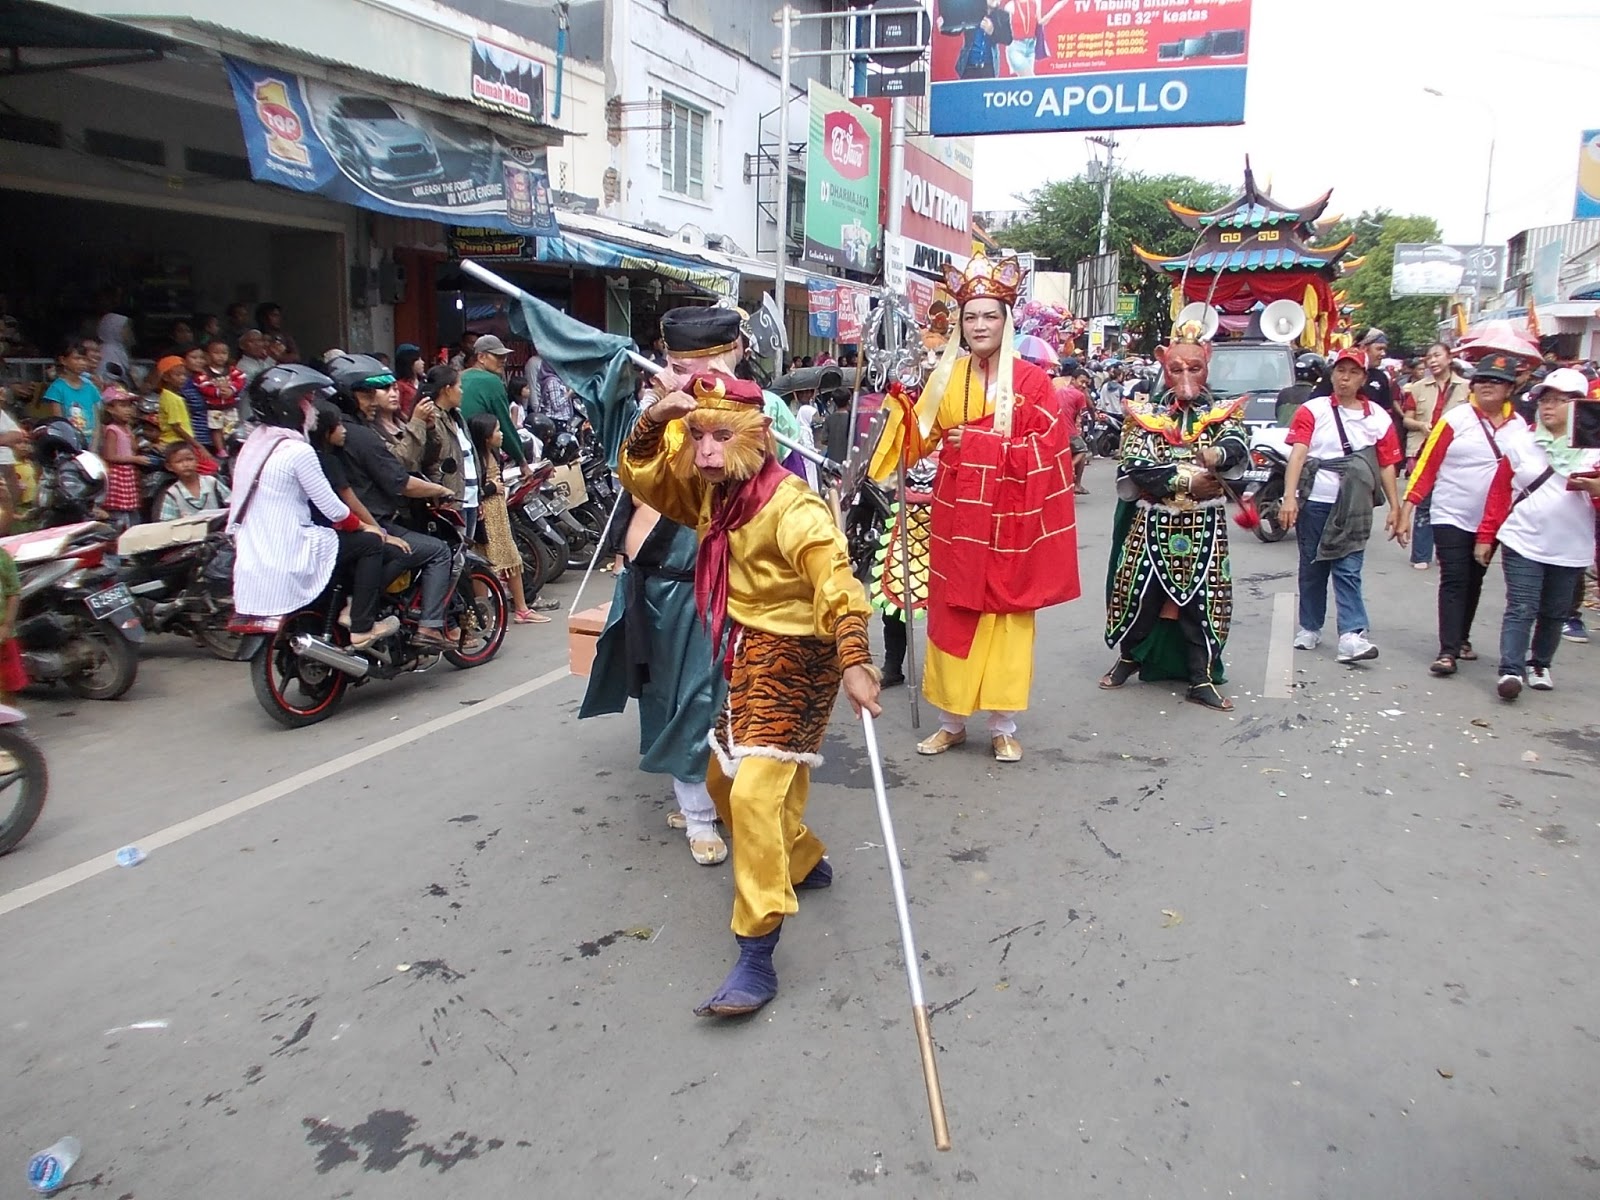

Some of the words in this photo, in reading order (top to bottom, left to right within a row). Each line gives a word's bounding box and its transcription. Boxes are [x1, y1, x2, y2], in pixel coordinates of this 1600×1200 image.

[1074, 0, 1091, 12] TV
[1107, 13, 1131, 27] LED
[1163, 9, 1208, 24] keatas
[475, 79, 503, 101] Rumah
[503, 88, 529, 109] Makan
[983, 90, 1033, 108] TOKO
[1035, 80, 1188, 117] APOLLO
[263, 108, 297, 133] TOP
[441, 182, 454, 193] THE
[447, 192, 457, 205] IN
[457, 189, 477, 203] YOUR
[476, 183, 503, 199] ENGINE
[903, 169, 968, 232] POLYTRON
